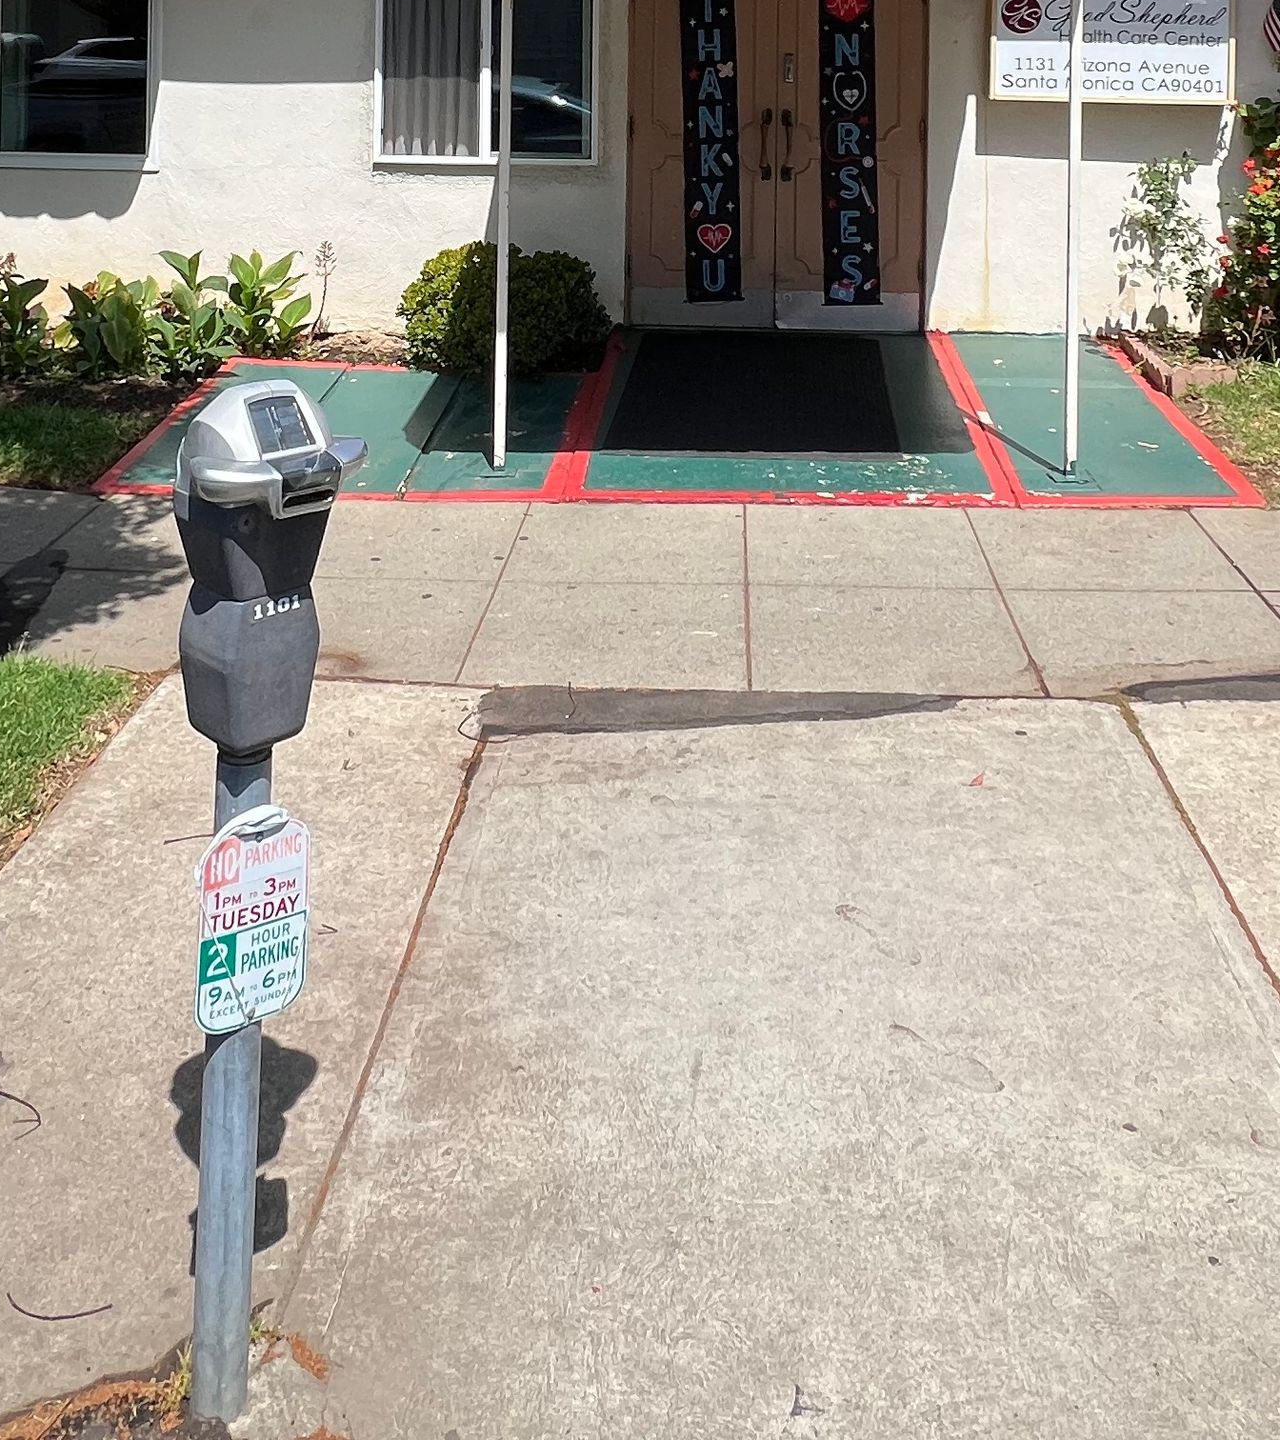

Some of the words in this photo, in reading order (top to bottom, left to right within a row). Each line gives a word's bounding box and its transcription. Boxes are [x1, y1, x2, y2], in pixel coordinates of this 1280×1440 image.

[1059, 29, 1113, 44] Halth
[1117, 29, 1159, 46] Care
[1164, 30, 1223, 47] Center
[1014, 57, 1056, 72] 1131
[1063, 57, 1132, 73] izona
[1138, 60, 1210, 75] Avenue
[1001, 73, 1058, 91] Santa
[1065, 76, 1135, 92] onica
[1141, 78, 1224, 94] CA90401
[253, 594, 301, 620] 1101
[244, 832, 302, 870] PARKING
[210, 892, 301, 933] TUESDAY
[251, 922, 291, 947] HOUR
[206, 943, 229, 978] 2
[240, 935, 299, 975] PARKING
[209, 1000, 250, 1020] EXCEPT
[254, 983, 294, 1006] SUNDAY
